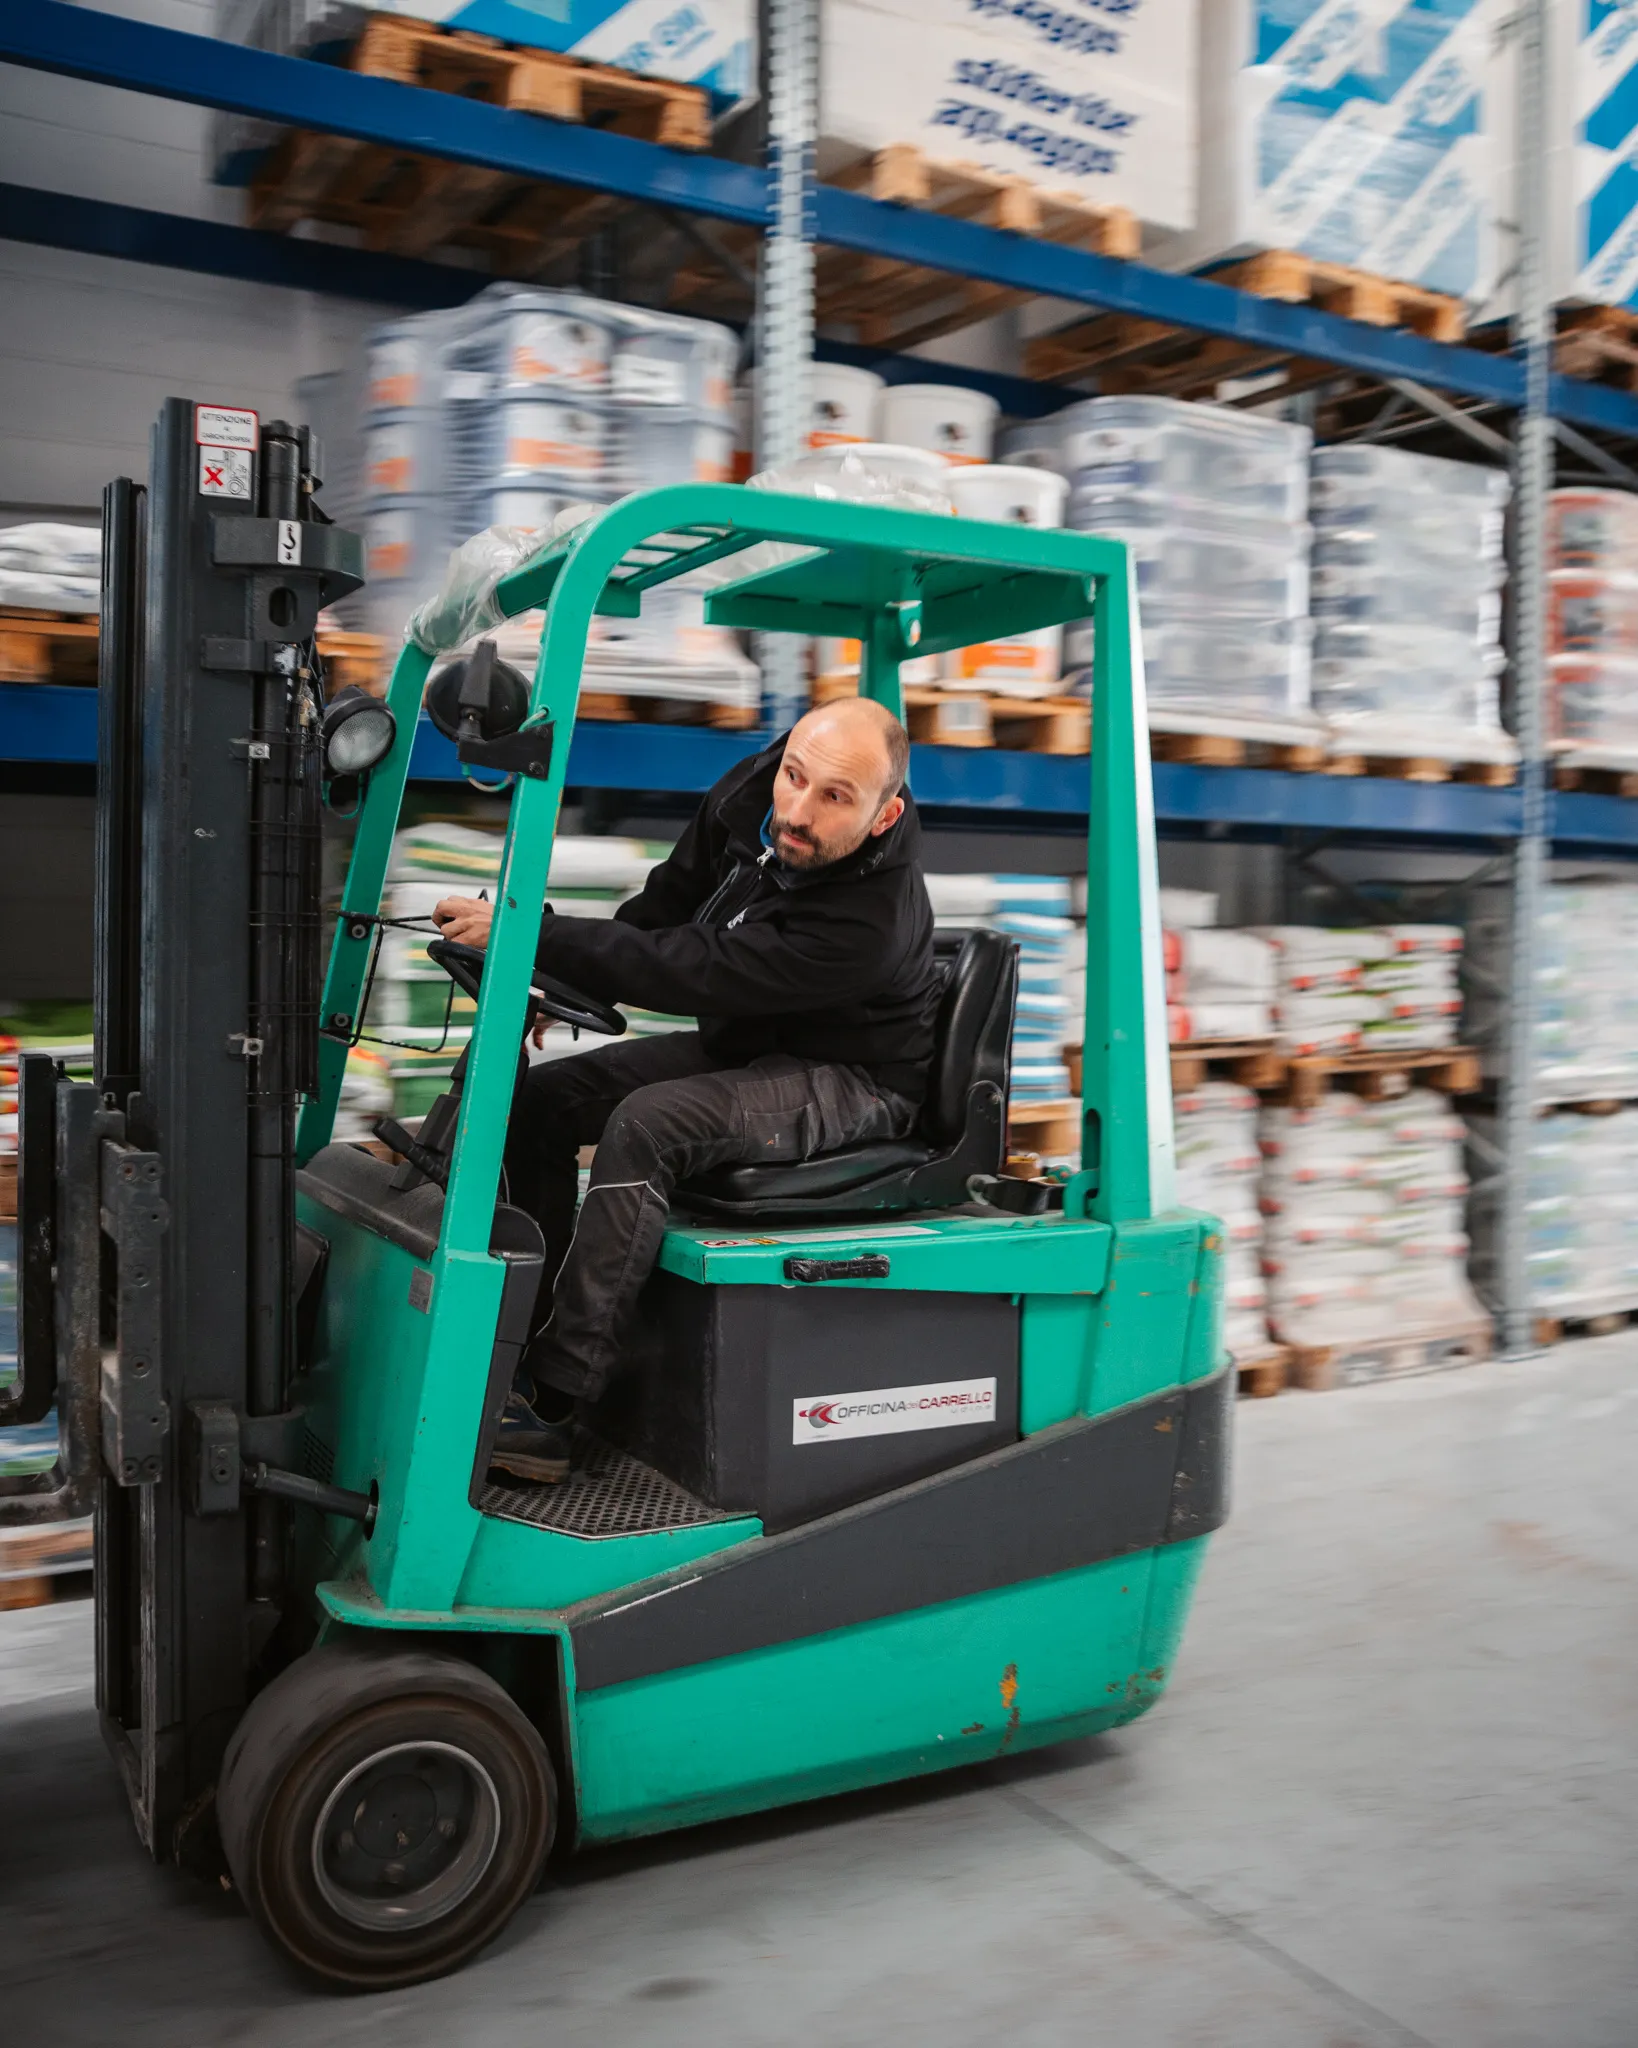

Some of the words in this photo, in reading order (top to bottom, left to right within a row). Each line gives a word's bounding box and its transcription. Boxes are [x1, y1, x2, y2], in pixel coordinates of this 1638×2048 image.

[201, 412, 252, 425] ATTENZIONE
[837, 1400, 907, 1419] OFFICINA
[918, 1391, 992, 1410] CARRELLO
